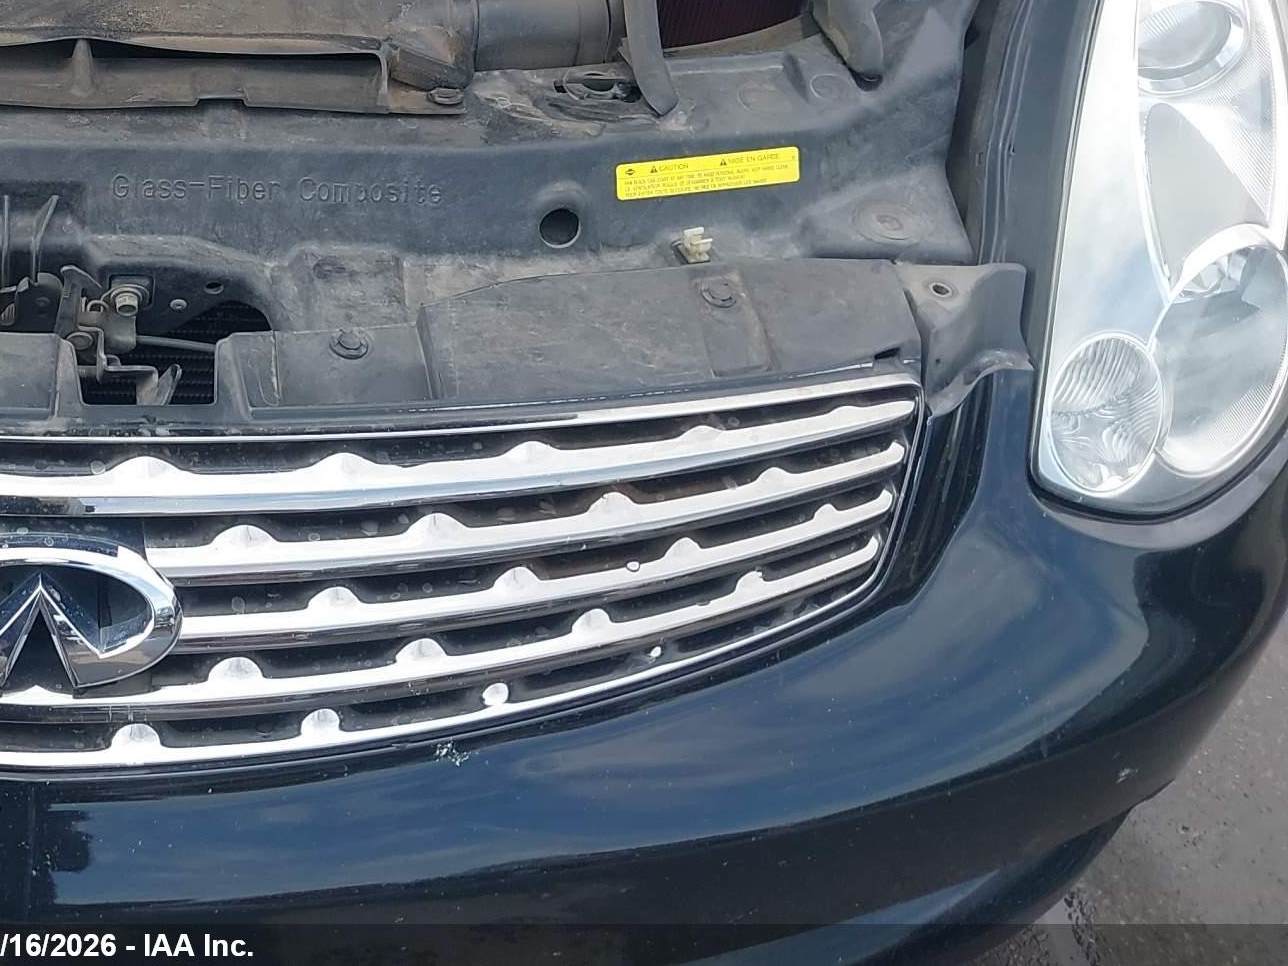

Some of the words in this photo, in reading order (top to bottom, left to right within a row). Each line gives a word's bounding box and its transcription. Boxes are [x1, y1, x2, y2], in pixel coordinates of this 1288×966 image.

[658, 163, 689, 173] CAUTION
[111, 173, 281, 202] Glass-Fiber
[299, 176, 443, 208] Composite
